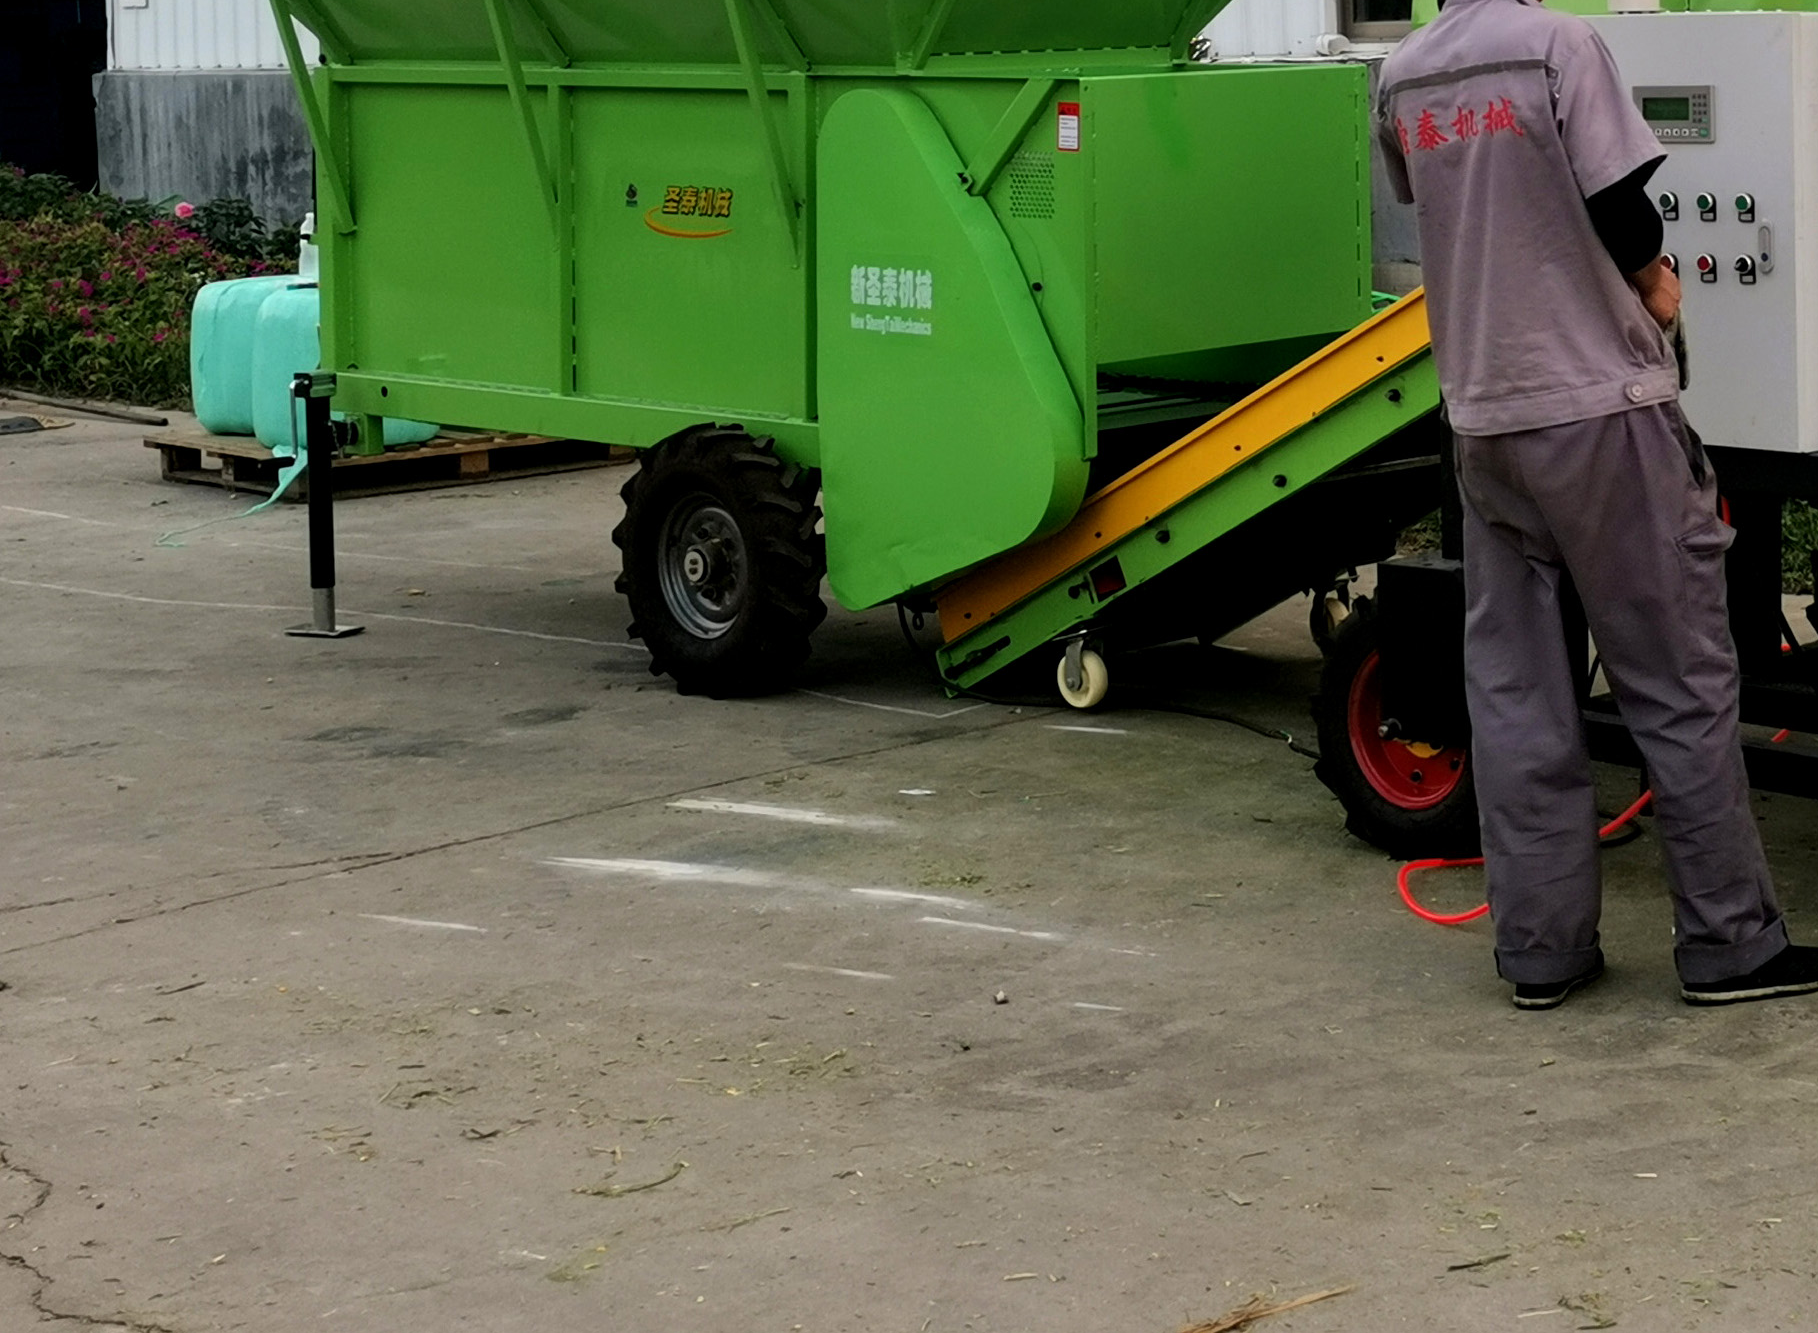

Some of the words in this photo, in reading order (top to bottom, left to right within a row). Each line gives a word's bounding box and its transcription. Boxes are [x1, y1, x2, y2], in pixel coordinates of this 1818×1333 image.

[662, 185, 733, 218] 圣泰机械
[851, 264, 932, 309] 新圣泰机械
